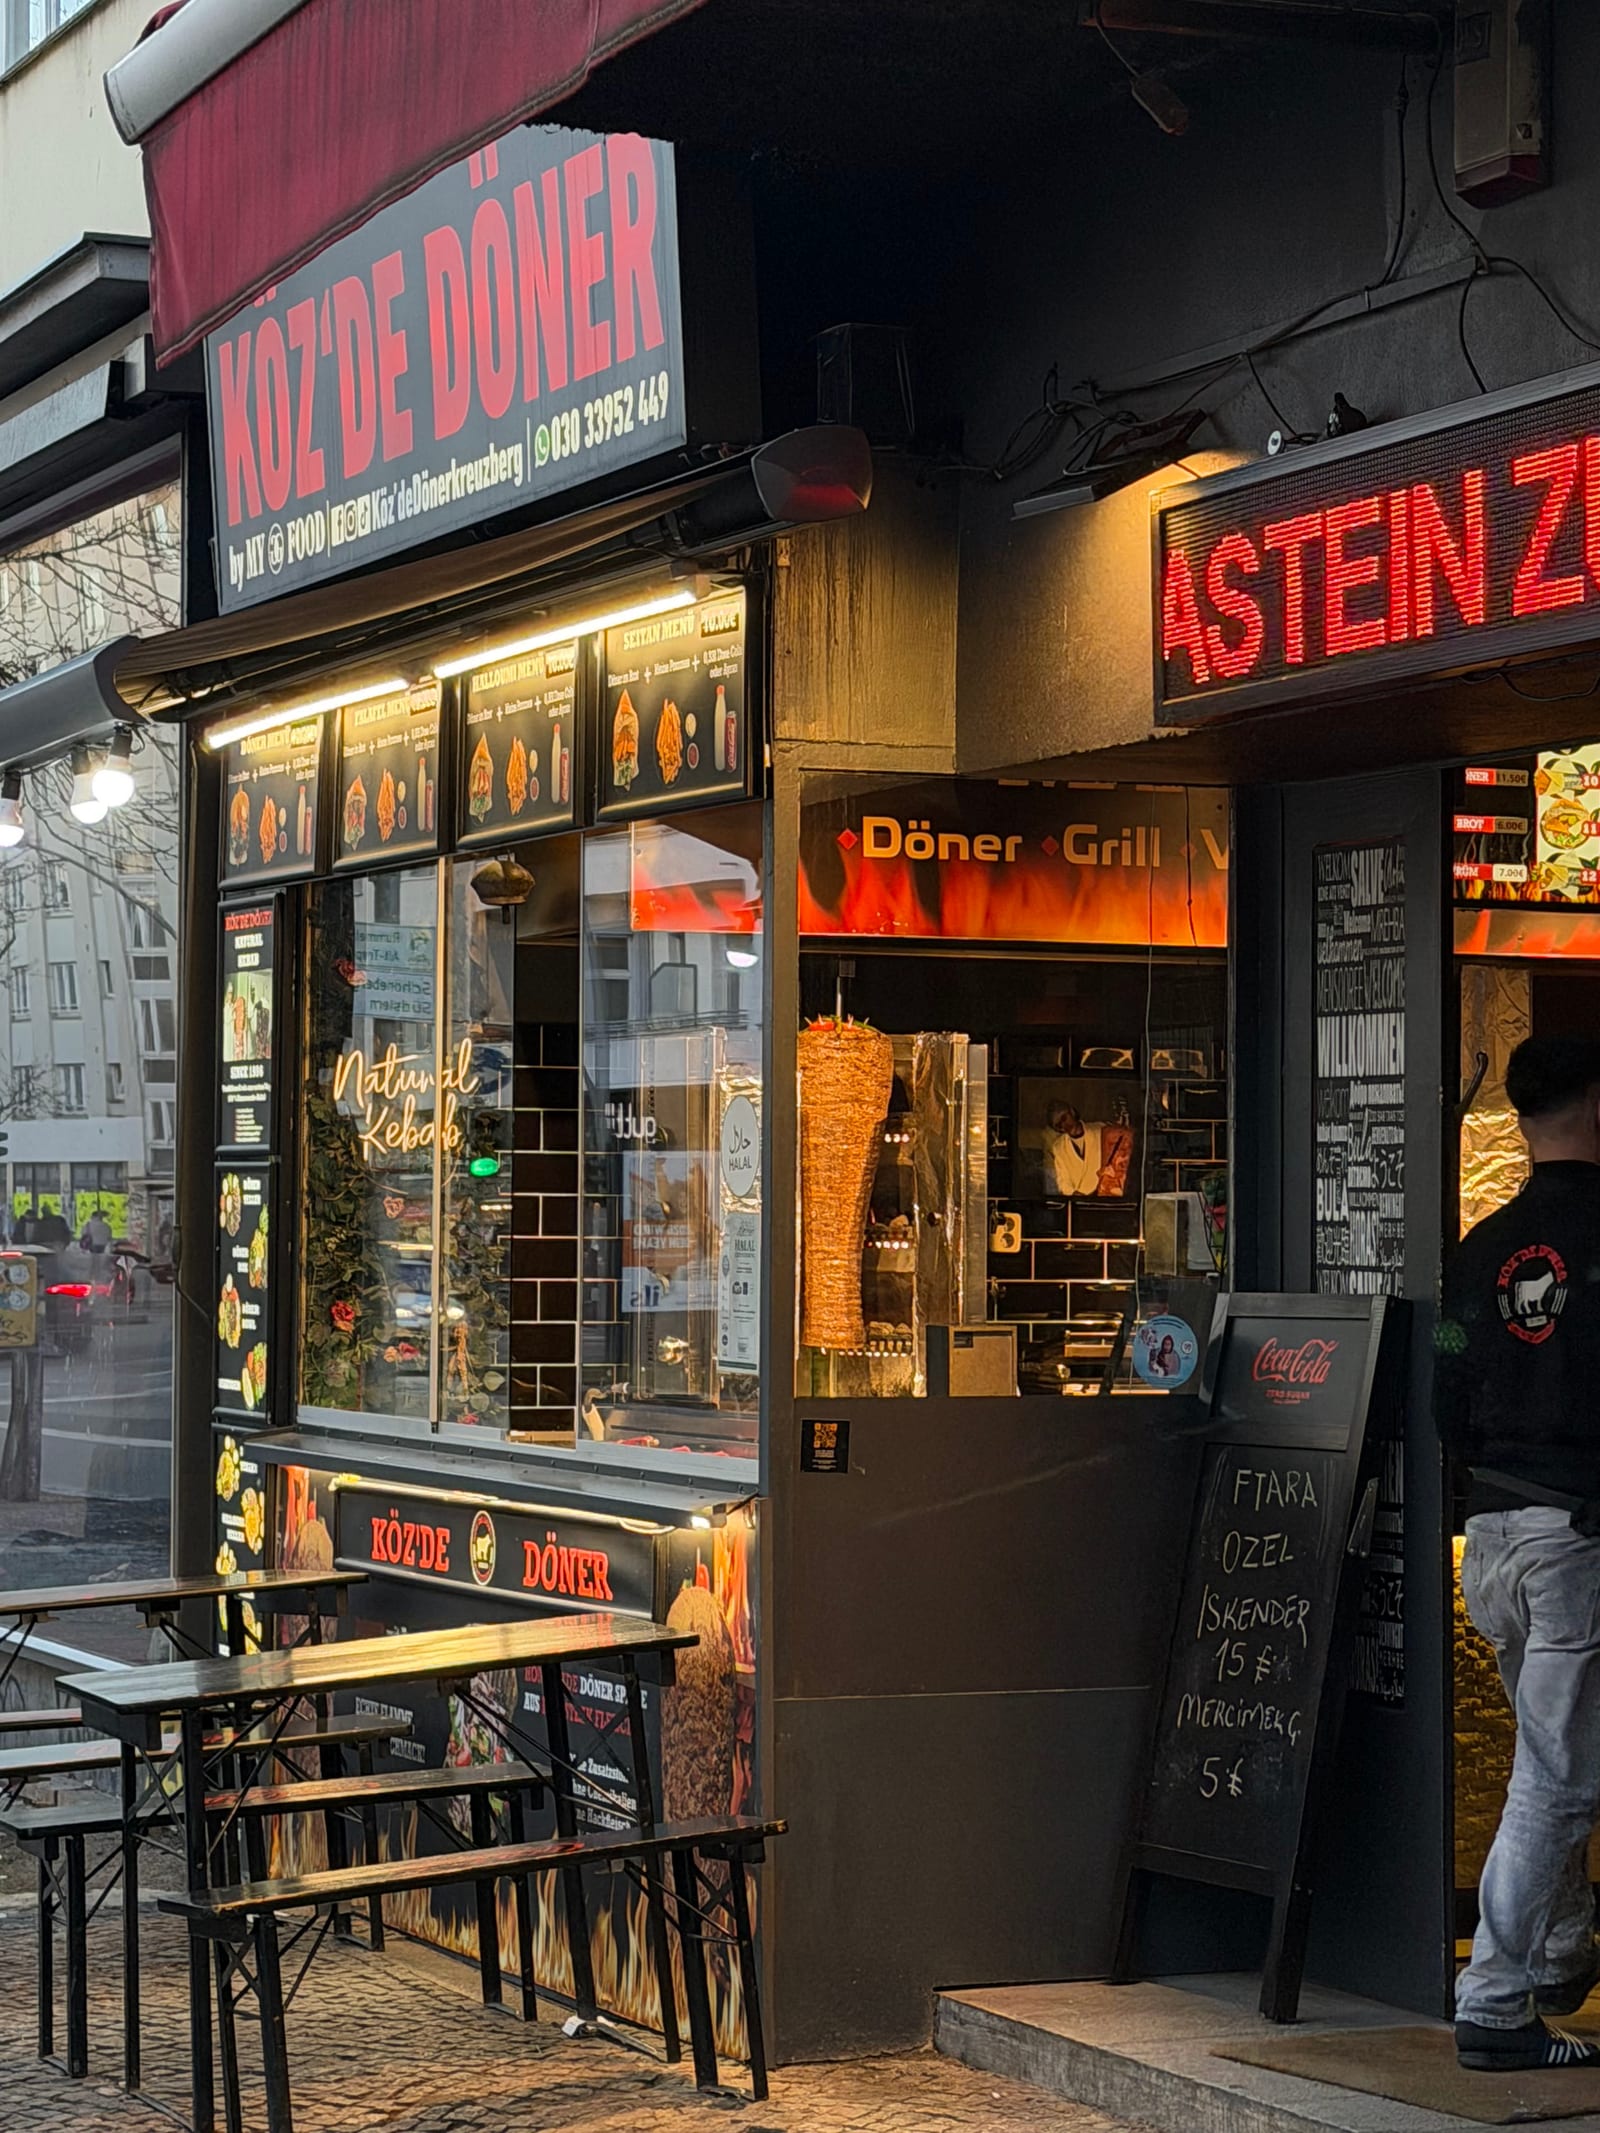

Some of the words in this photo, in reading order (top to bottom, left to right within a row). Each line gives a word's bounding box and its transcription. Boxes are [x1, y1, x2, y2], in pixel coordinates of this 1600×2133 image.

[423, 132, 666, 441] DÖNER
[228, 545, 244, 592] by
[245, 532, 265, 580] MY
[287, 509, 326, 565] FOOD
[551, 408, 580, 462] 030
[584, 385, 634, 449] 33952
[638, 370, 669, 426] 449
[1162, 468, 1487, 685] ASTEIN
[1511, 434, 1600, 617] Z
[623, 623, 661, 651] SEITAN
[661, 610, 696, 641] MENÜ
[862, 815, 1023, 863] Döner
[1063, 823, 1161, 868] Grill
[1455, 818, 1485, 830] BROT
[1350, 847, 1384, 908] SALVE
[1363, 957, 1405, 1009] WELCOME
[1316, 1012, 1405, 1078] WILLKOMMEN
[333, 1037, 480, 1108] Natural
[358, 1094, 462, 1162] Kebab
[728, 1155, 752, 1171] HALAL
[1316, 1177, 1349, 1222] BULA
[371, 1508, 451, 1573] KÖZ'DE
[522, 1530, 614, 1601] DÖNER
[1215, 1636, 1247, 1682] 15
[523, 1691, 540, 1713] AUS
[579, 1673, 613, 1701] DÖNER
[1199, 1756, 1221, 1799] 5
